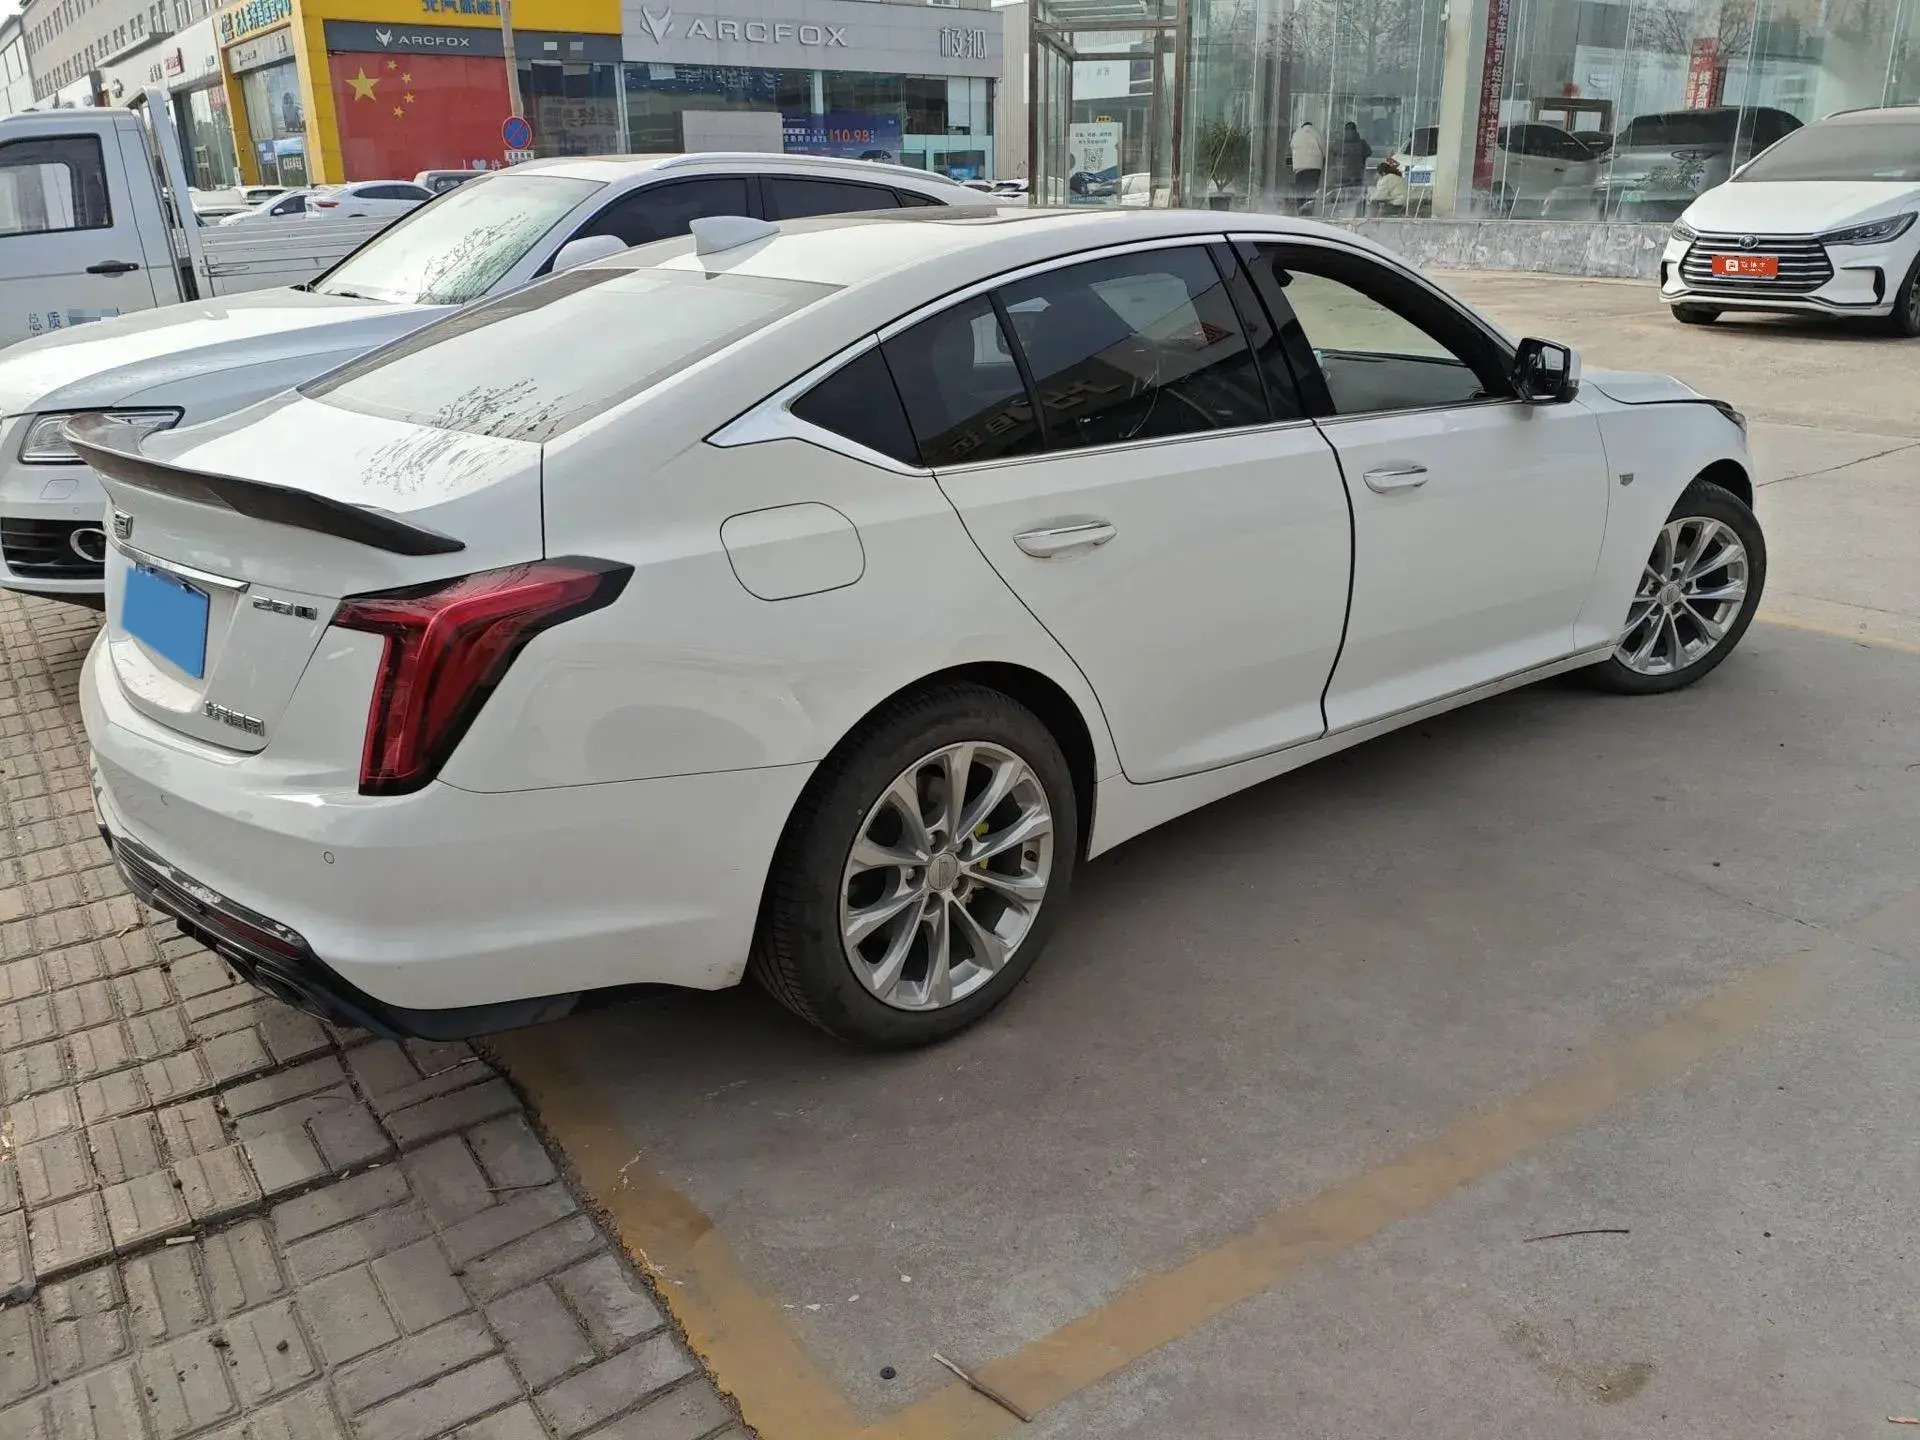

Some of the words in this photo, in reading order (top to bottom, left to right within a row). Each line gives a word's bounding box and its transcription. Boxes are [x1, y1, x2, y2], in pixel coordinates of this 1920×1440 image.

[397, 35, 470, 48] ARCFOX
[685, 18, 849, 48] ARCFOX
[940, 24, 988, 60] 极狐
